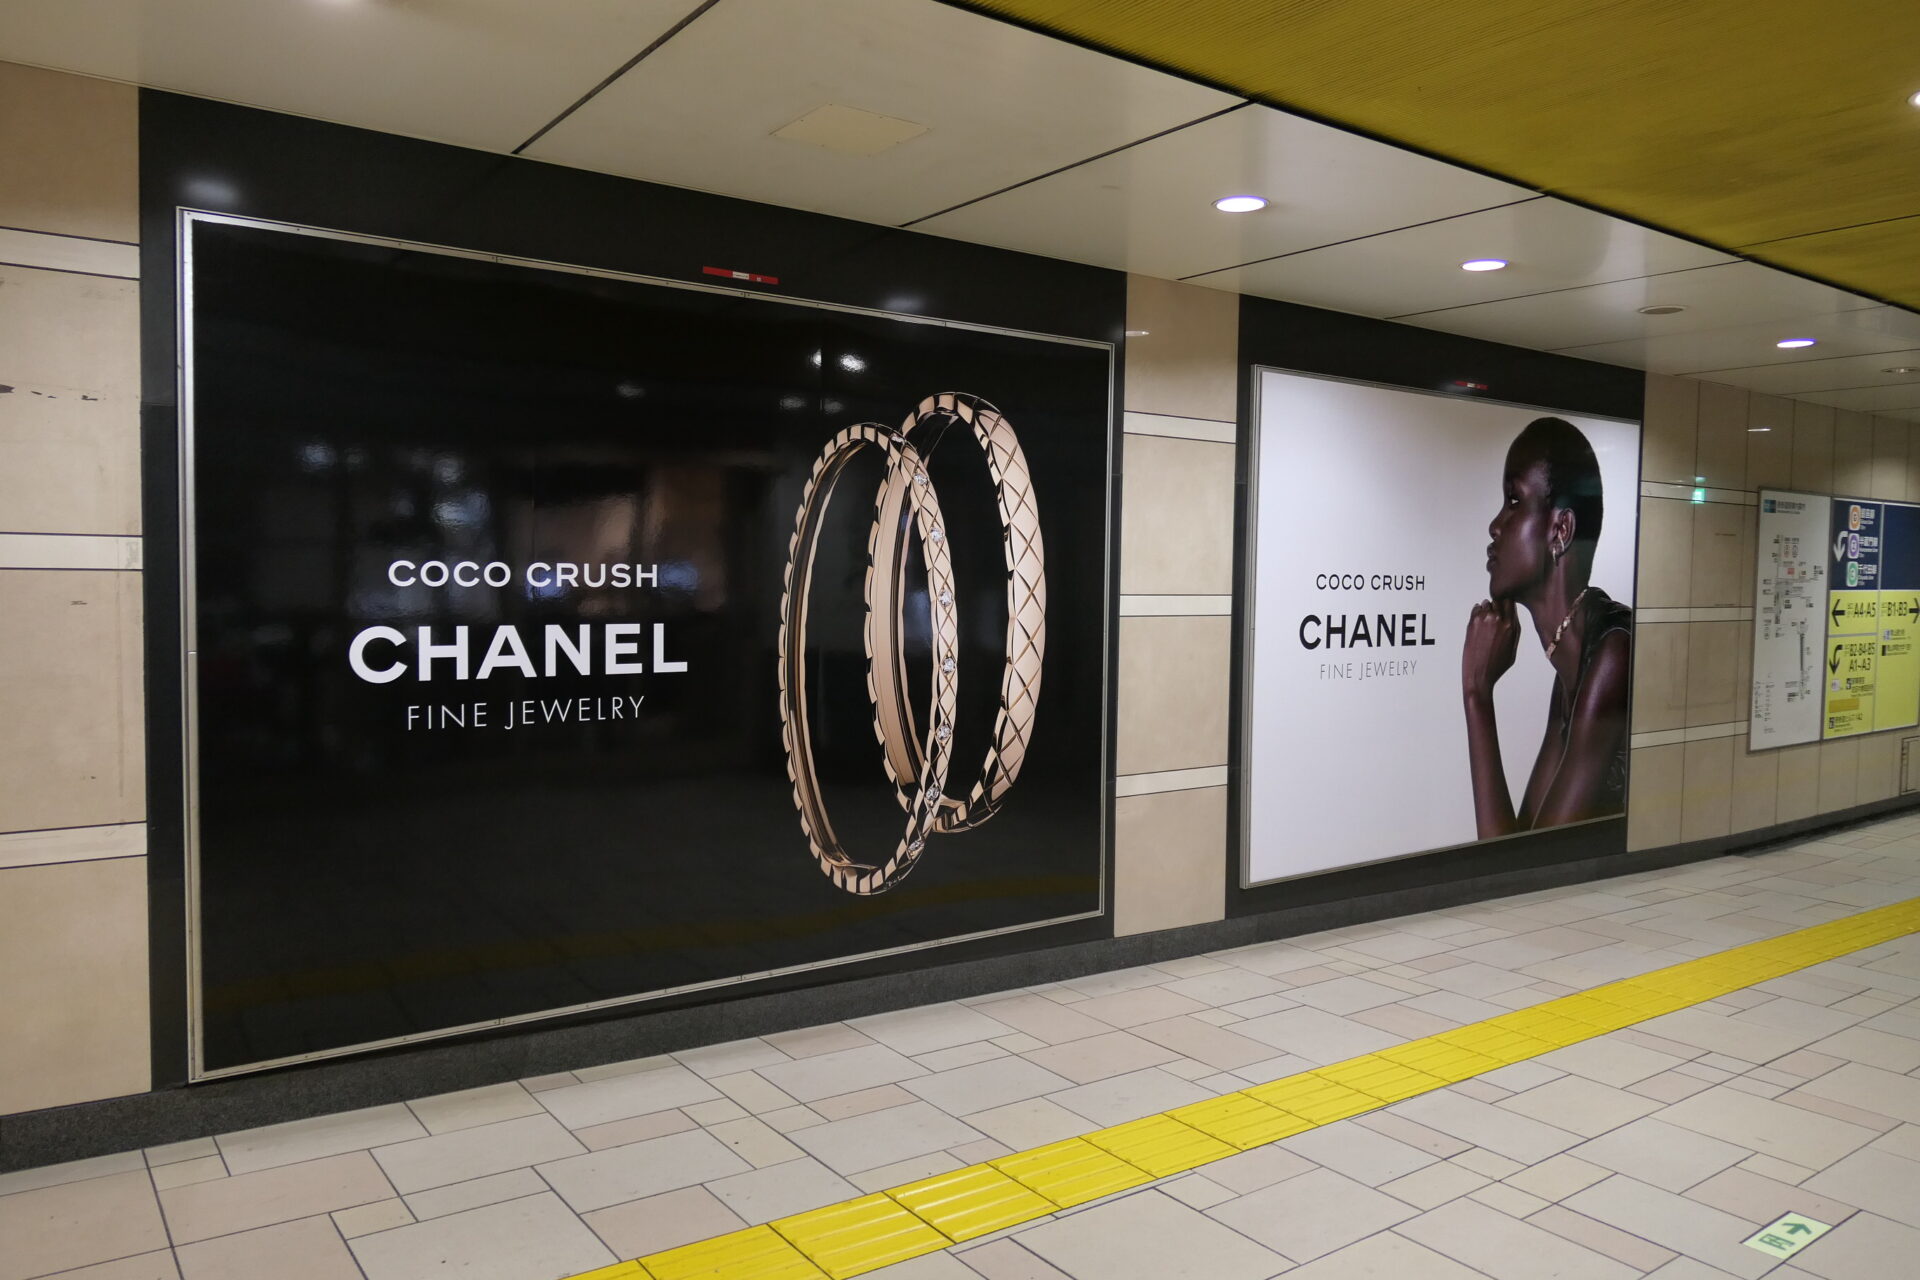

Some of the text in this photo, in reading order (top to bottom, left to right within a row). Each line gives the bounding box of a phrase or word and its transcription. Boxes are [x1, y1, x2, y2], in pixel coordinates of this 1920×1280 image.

[388, 560, 658, 588] COCO CRUSH
[1316, 574, 1425, 591] COCO CRUSH
[1299, 613, 1436, 650] CHANEL
[349, 623, 688, 684] CHANEL
[1319, 659, 1417, 680] FINE JEWELRY
[407, 695, 645, 731] FINE JEWELRY
